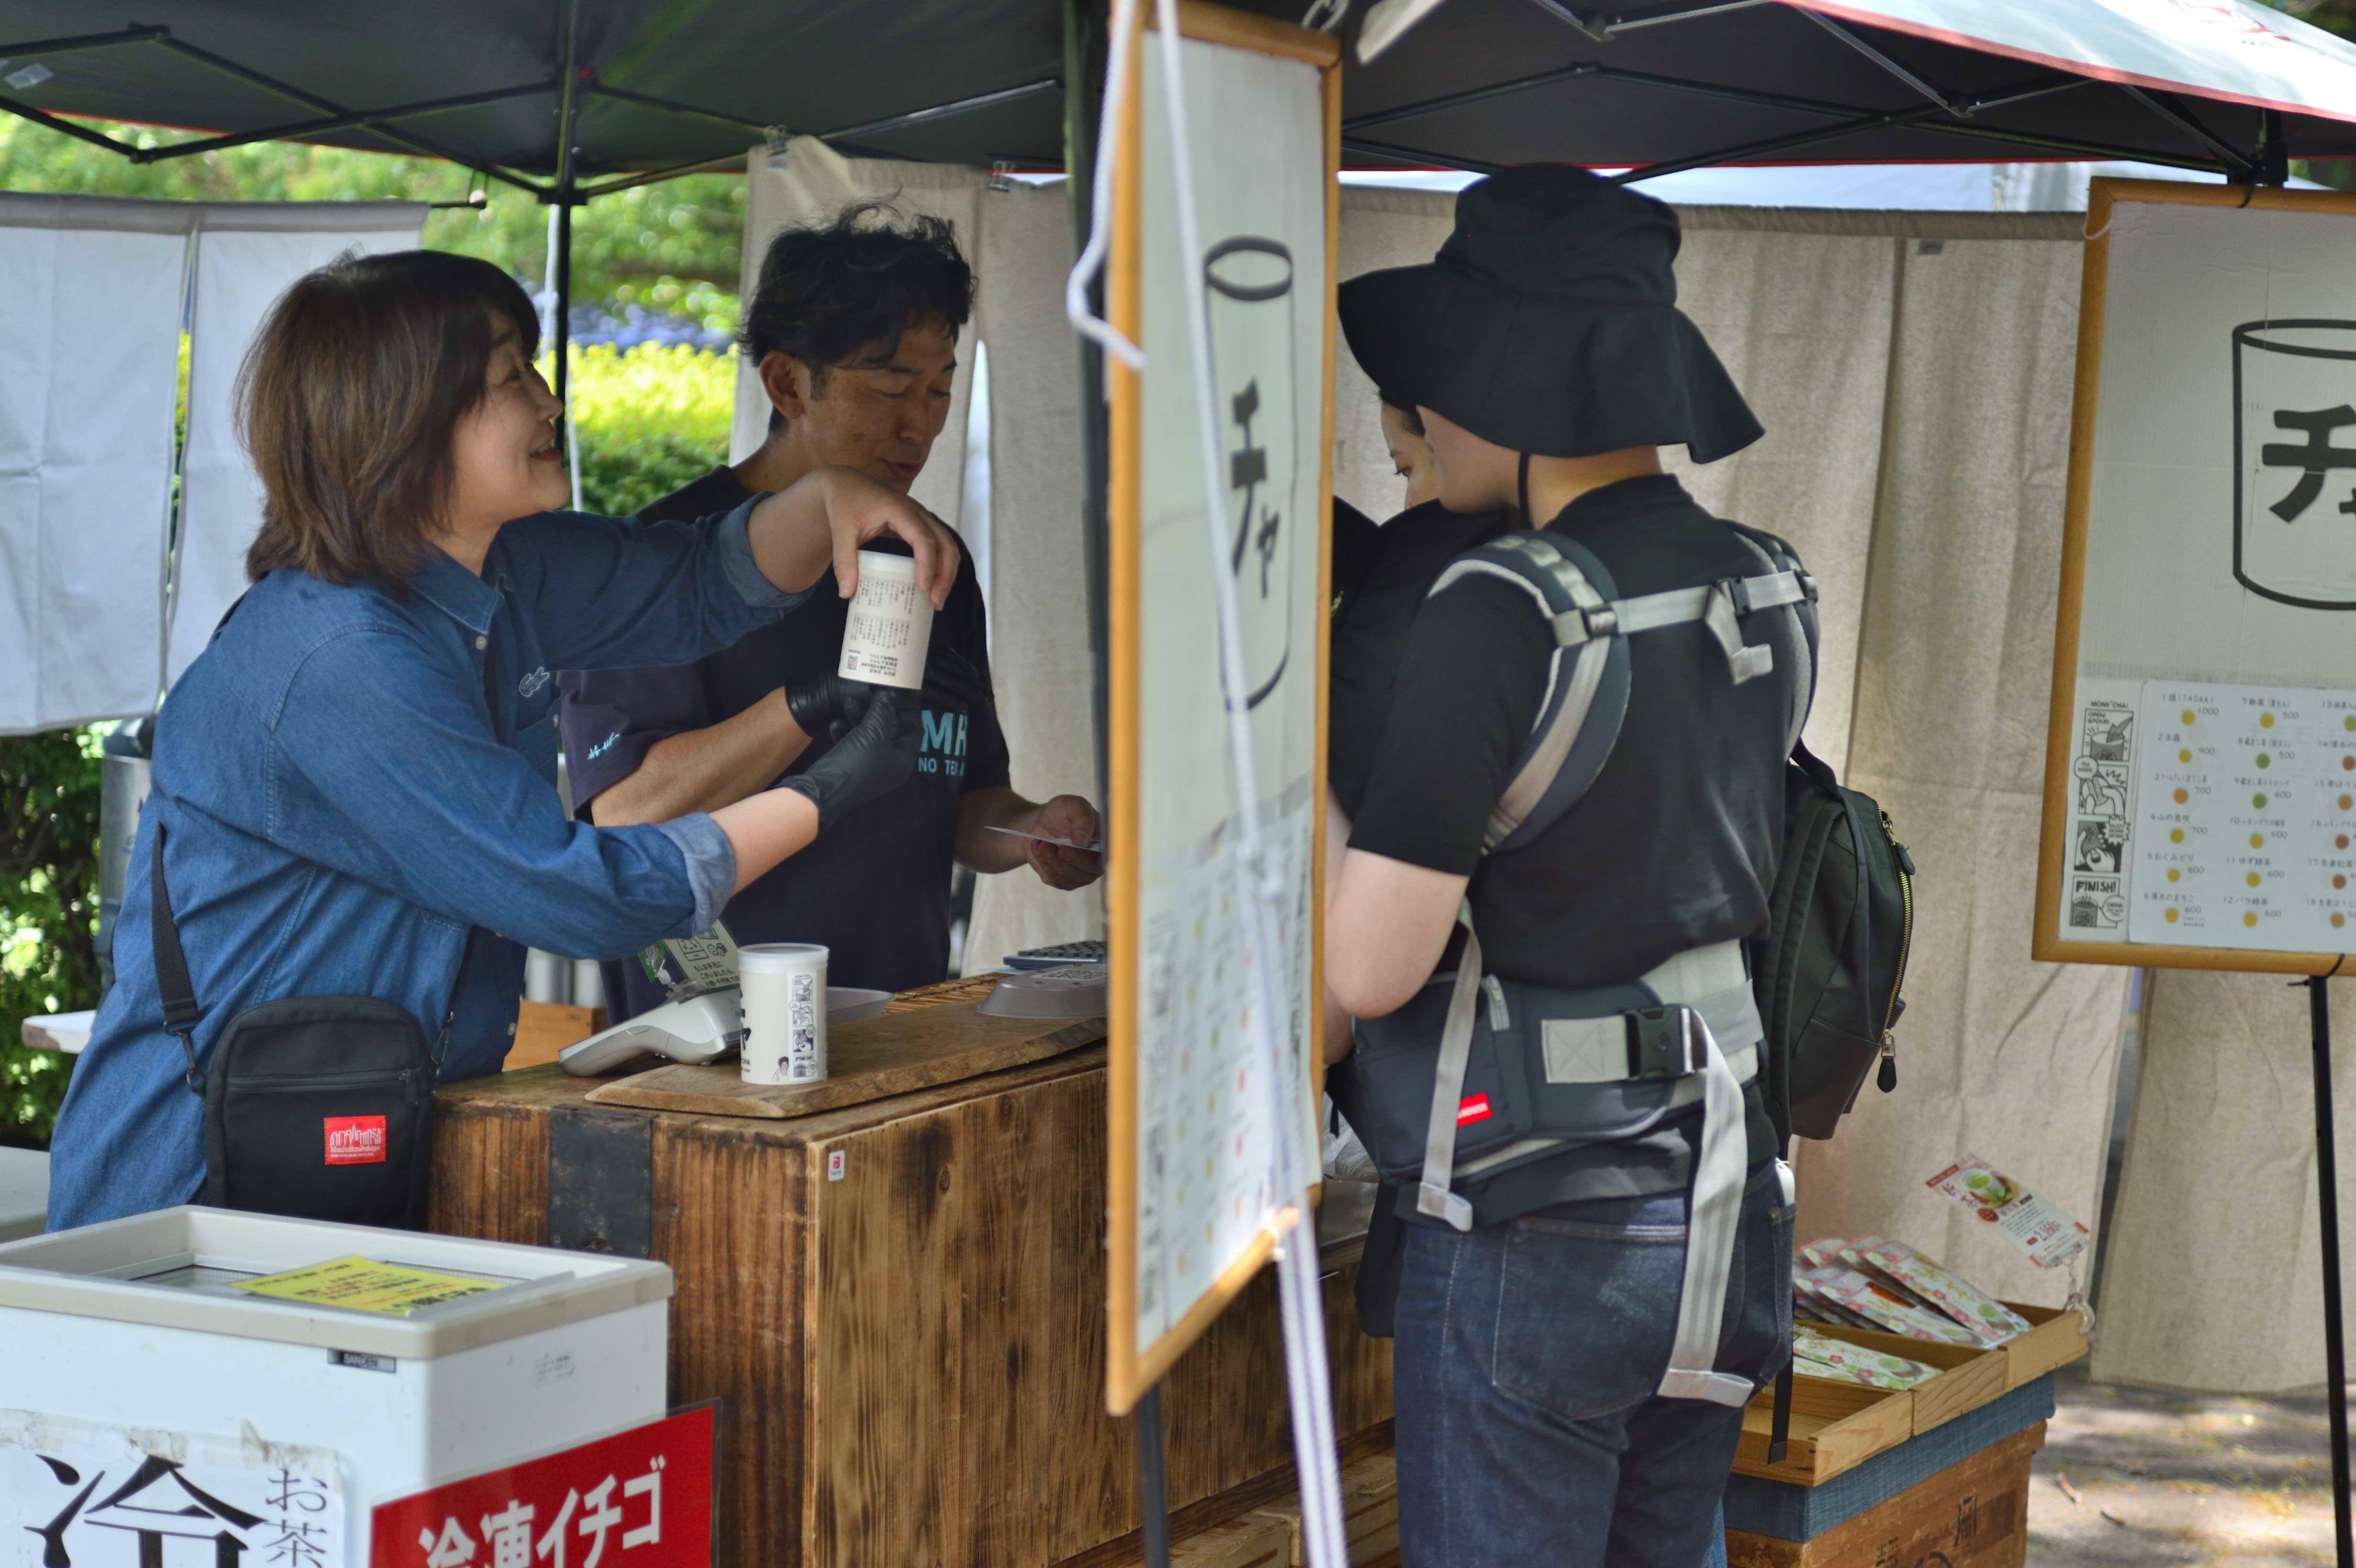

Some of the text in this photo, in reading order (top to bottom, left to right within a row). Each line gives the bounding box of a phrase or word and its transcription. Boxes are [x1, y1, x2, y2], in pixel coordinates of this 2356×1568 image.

[2262, 404, 2356, 523] チ
[918, 757, 937, 773] NO
[2155, 853, 2193, 862] おくみどり
[2076, 880, 2116, 893] FINISH!
[694, 961, 723, 971] もしお手元に
